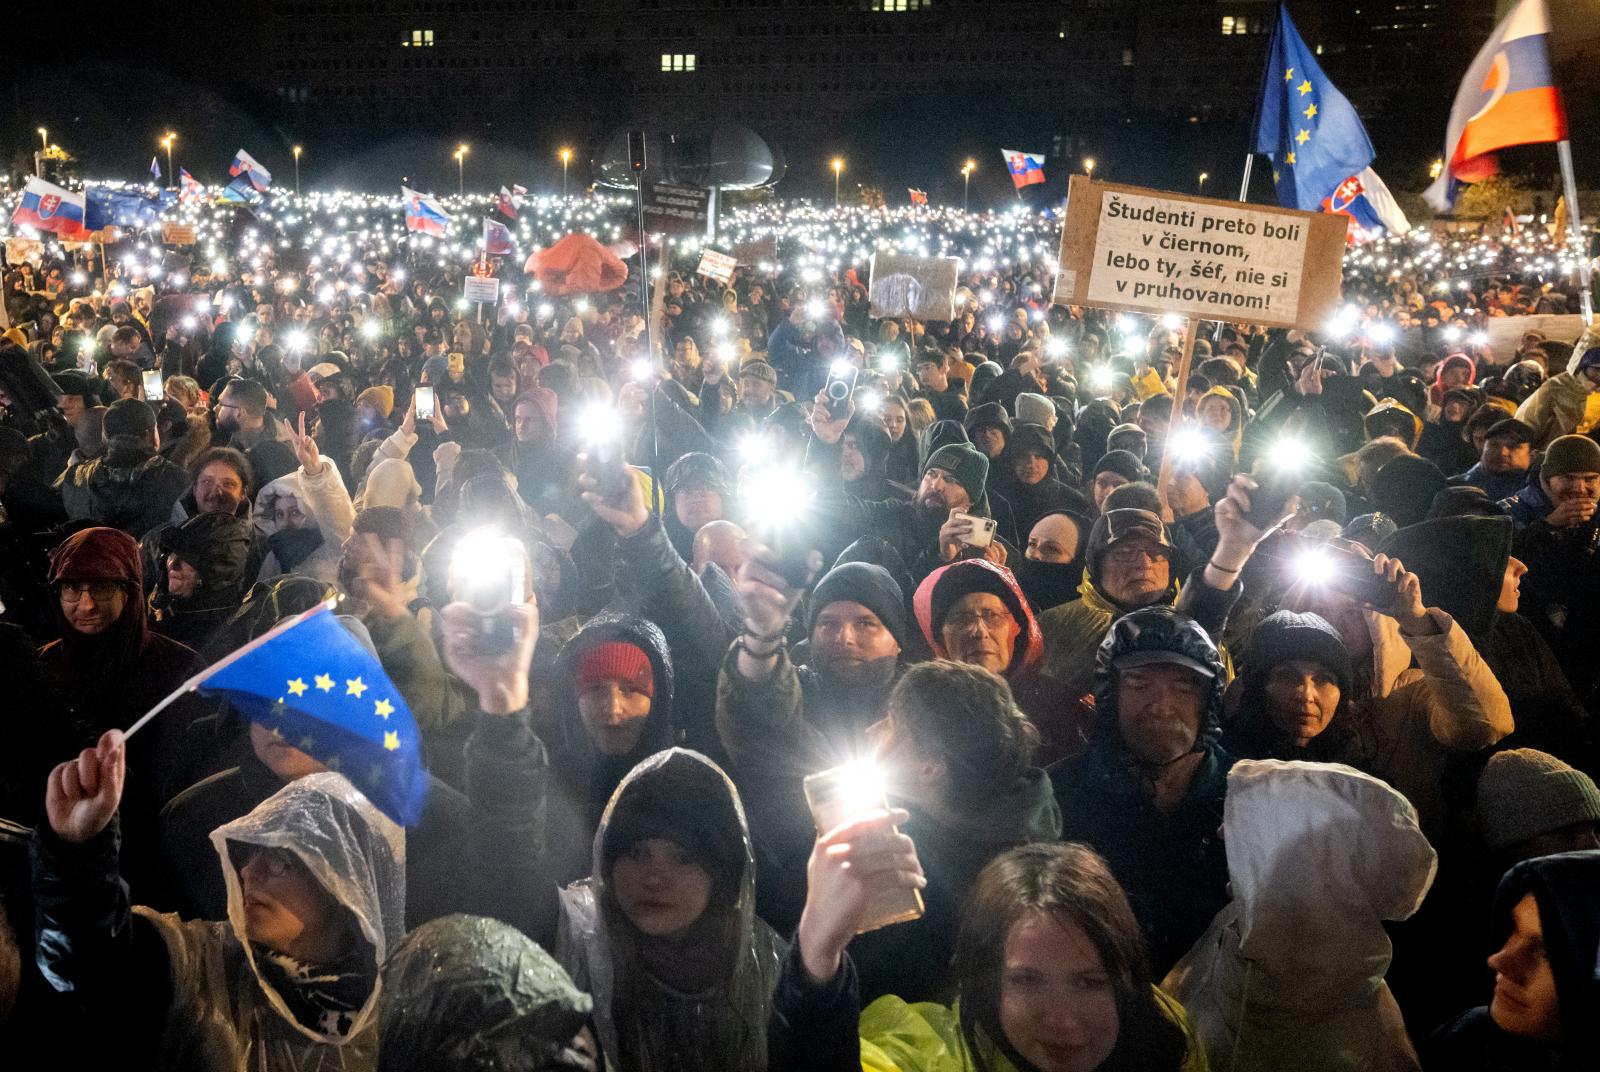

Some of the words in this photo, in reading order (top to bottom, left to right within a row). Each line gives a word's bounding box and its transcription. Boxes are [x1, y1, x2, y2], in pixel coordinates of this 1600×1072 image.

[1107, 196, 1196, 228] Študenti
[1201, 217, 1257, 235] preto
[1263, 221, 1300, 241] boli
[1142, 234, 1154, 246] v
[1159, 231, 1250, 262] čiernom,
[1106, 250, 1150, 271] lebo
[1157, 257, 1182, 278] ty,
[1190, 259, 1228, 284] šéf,
[1235, 270, 1265, 285] nie
[1271, 272, 1288, 288] si
[1116, 280, 1128, 292] v
[1134, 282, 1271, 310] pruhovanom!
